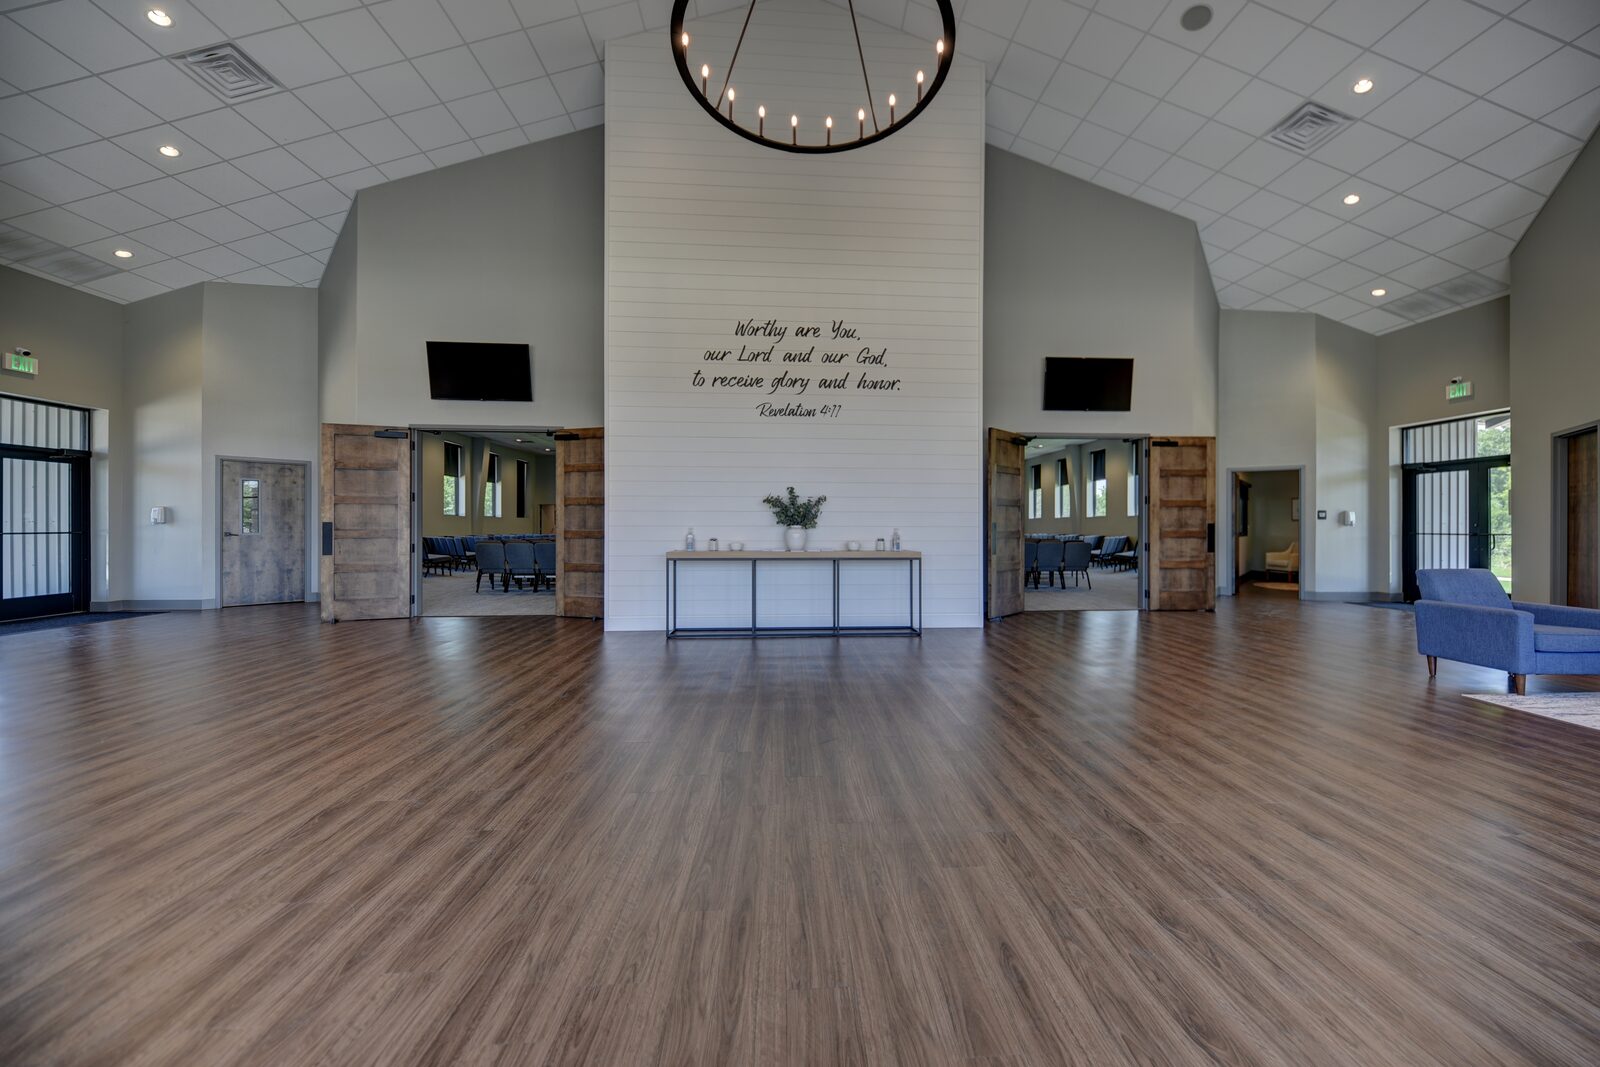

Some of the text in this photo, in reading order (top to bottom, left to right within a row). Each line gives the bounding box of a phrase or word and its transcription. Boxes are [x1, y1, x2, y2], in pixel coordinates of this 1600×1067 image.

[735, 318, 788, 343] Worthy
[794, 326, 821, 338] are
[12, 354, 33, 372] EXIT
[703, 350, 732, 361] our
[736, 345, 774, 362] Lord
[782, 346, 815, 363] and
[821, 353, 849, 364] our
[692, 370, 901, 395] to receive glory and honor.
[1449, 383, 1466, 399] EXIT
[756, 402, 817, 418] Revelation
